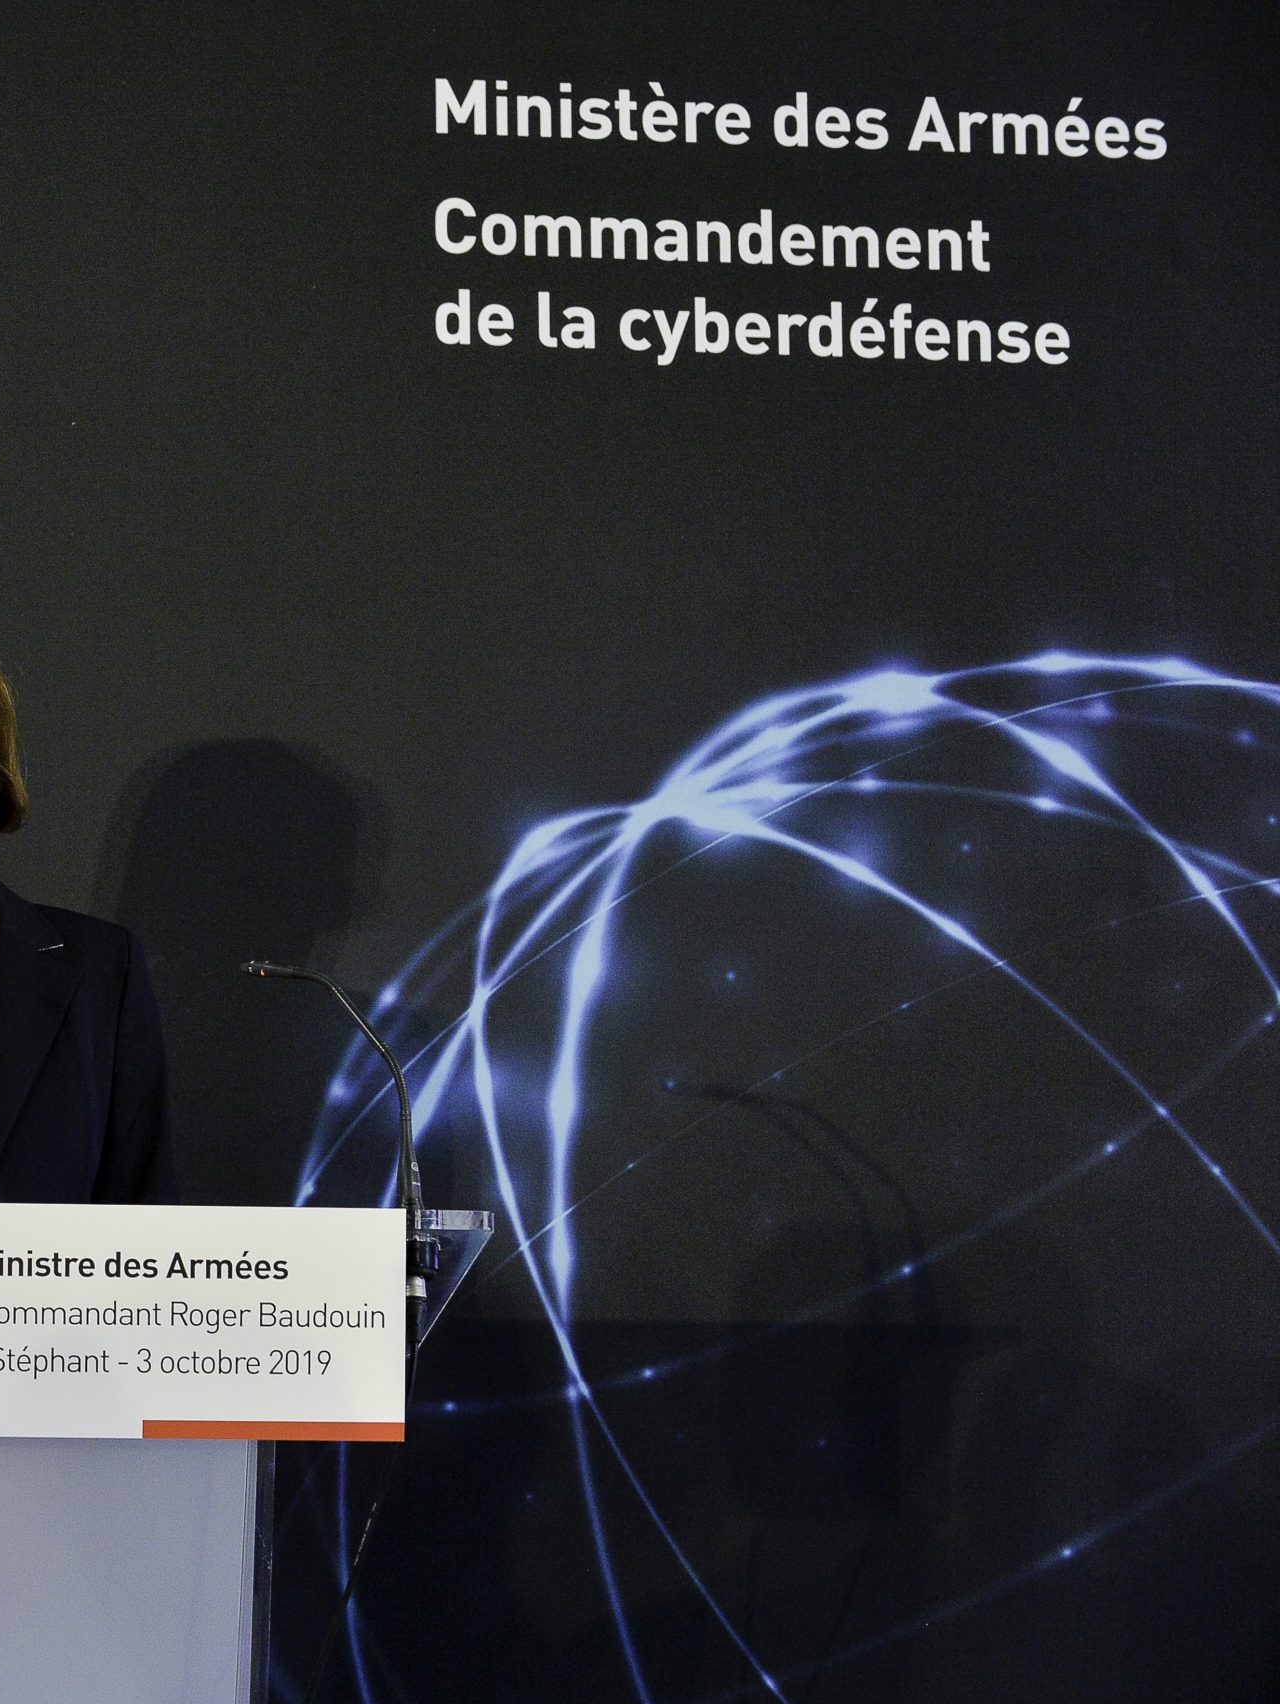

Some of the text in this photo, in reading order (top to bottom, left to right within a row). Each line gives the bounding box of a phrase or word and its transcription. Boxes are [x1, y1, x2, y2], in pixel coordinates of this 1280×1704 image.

[434, 77, 1168, 161] Ministère des Armées
[434, 197, 991, 273] Commandement
[434, 288, 1071, 367] de la cyberdéfense
[104, 1251, 159, 1279] des
[165, 1250, 289, 1280] Armées
[170, 1301, 252, 1335] Roger
[259, 1302, 385, 1329] Baudouin
[136, 1348, 152, 1374] 3
[160, 1349, 261, 1375] octobre
[269, 1349, 332, 1376] 2019
